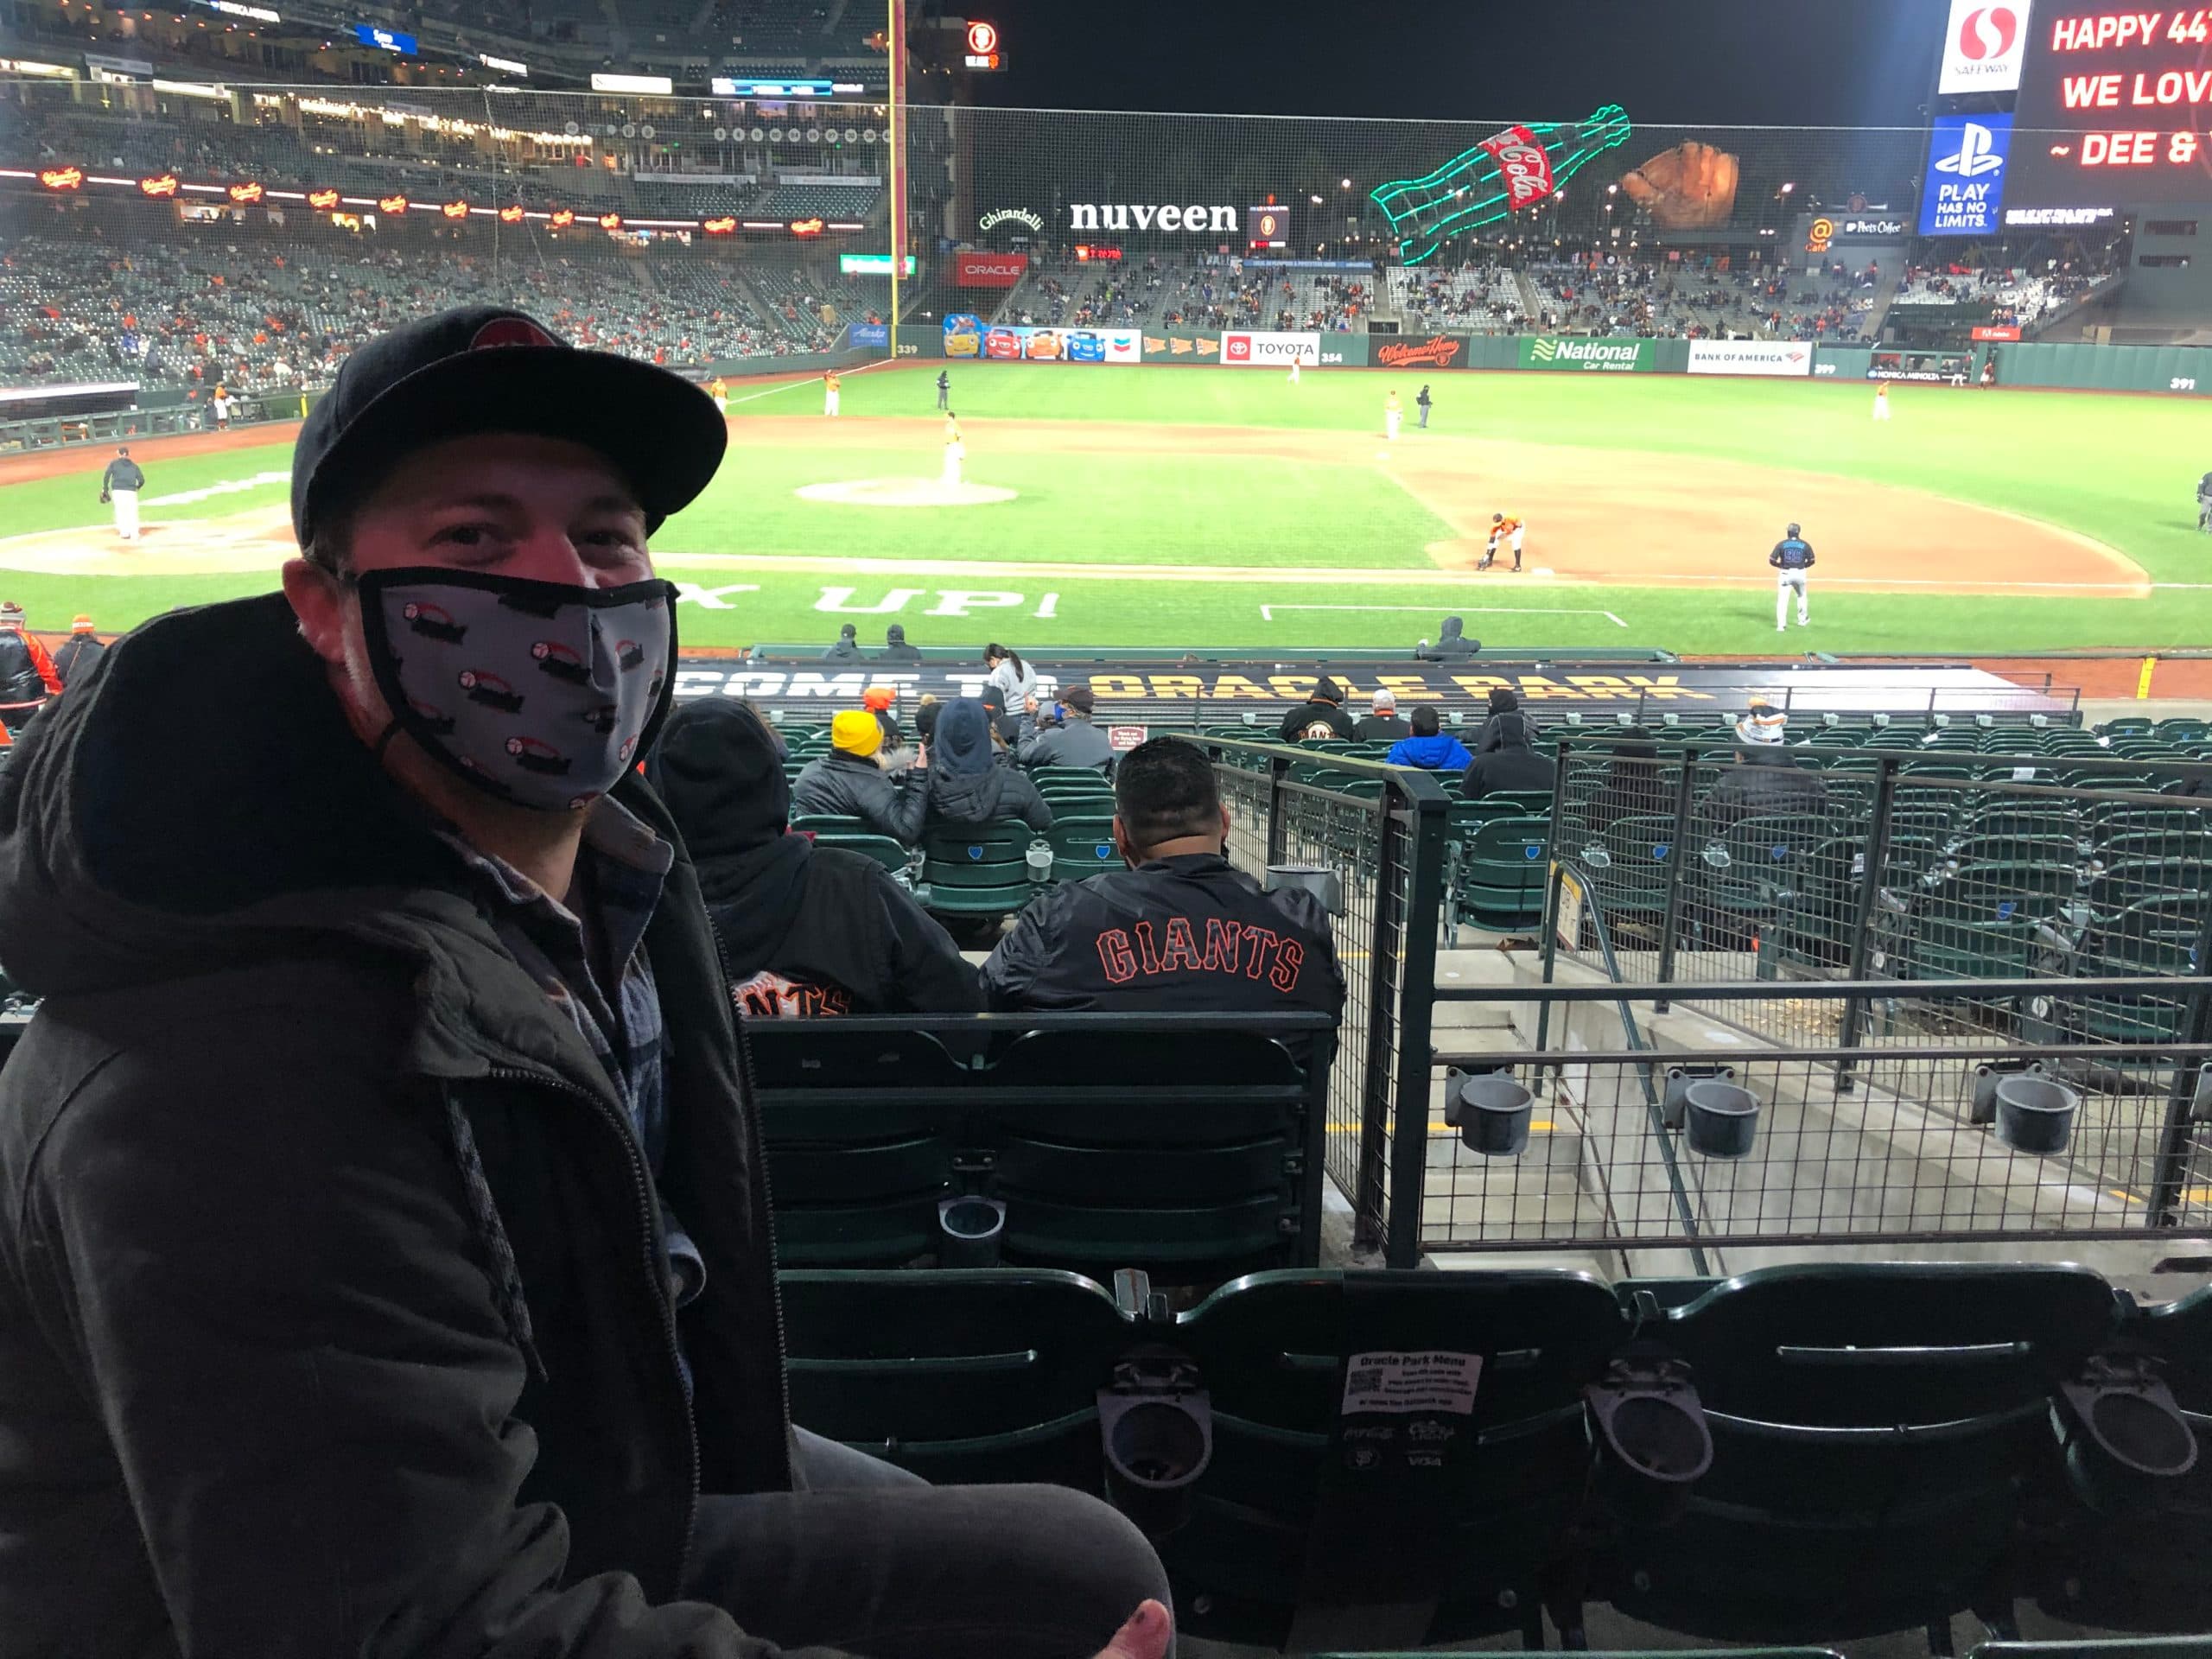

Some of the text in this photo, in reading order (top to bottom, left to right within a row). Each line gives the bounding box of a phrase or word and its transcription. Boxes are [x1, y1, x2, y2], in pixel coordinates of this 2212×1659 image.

[2052, 10, 2212, 50] HAPPY 44
[1955, 65, 2011, 76] SAFEWAY
[2063, 71, 2212, 107] WE LOV
[2081, 132, 2157, 165] DEE
[2169, 131, 2197, 162] &
[1939, 183, 1990, 201] PLAY
[1937, 201, 1986, 213] HAS NO
[979, 207, 1044, 232] Ghirardelli
[1070, 203, 1238, 232] nuveen
[965, 264, 1020, 275] ORACLE
[897, 345, 918, 354] 339
[1256, 343, 1313, 355] TOYOTA
[1555, 341, 1640, 360] National
[1320, 353, 1342, 363] 354
[1583, 361, 1635, 370] Car Rental
[1694, 353, 1720, 361] BANK
[1738, 354, 1783, 363] AMERICA
[2170, 378, 2196, 391] 391
[814, 586, 1059, 619] UP!
[1089, 675, 1444, 699] ORACLE
[1450, 676, 1717, 699] PARK
[1096, 917, 1305, 993] GIANTS
[1360, 1355, 1466, 1367] Oracle Park Menu
